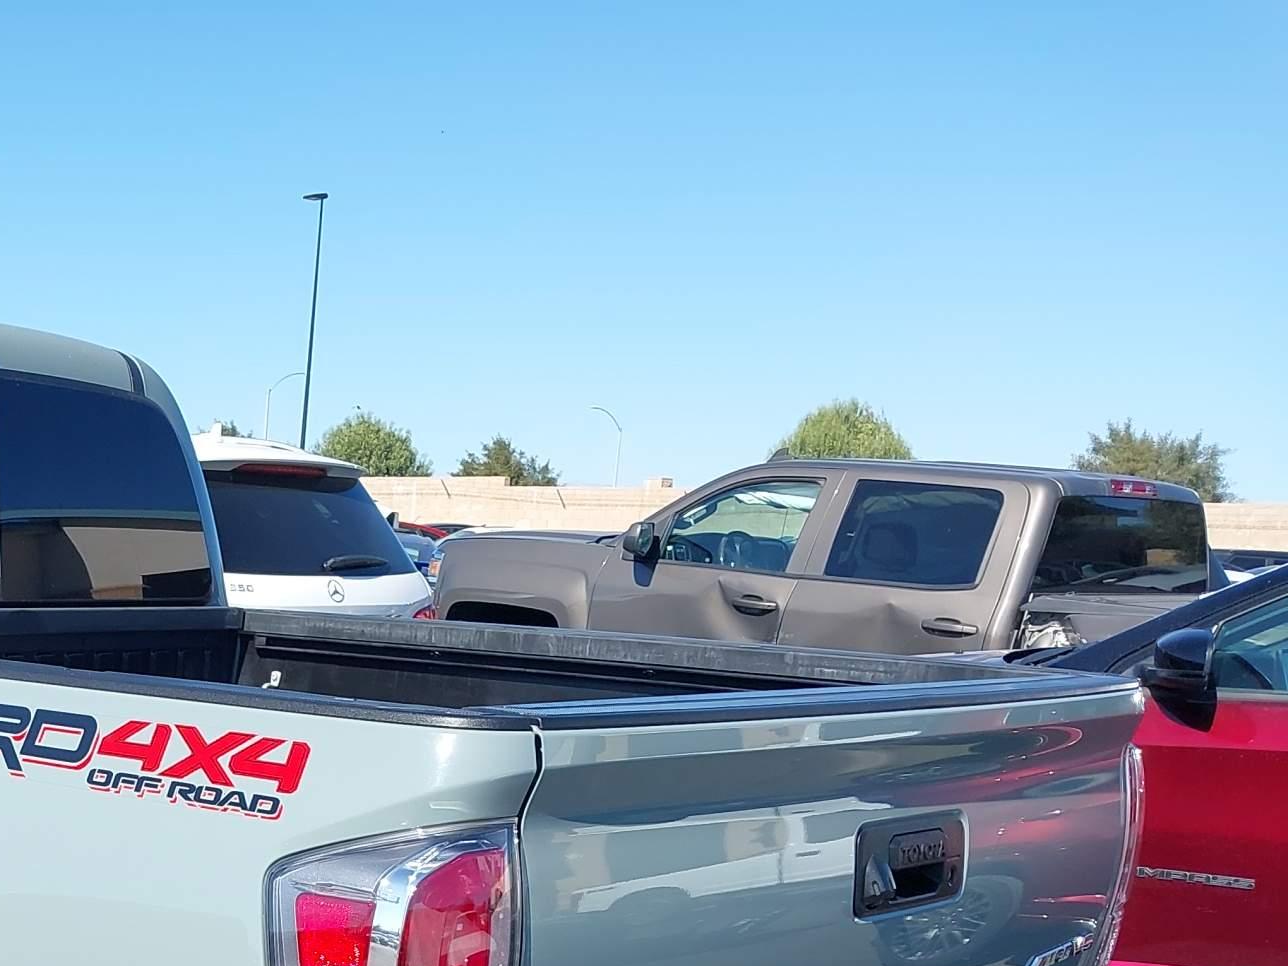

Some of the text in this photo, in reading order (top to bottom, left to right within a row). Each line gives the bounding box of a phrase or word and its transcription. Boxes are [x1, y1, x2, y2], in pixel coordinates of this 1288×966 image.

[98, 720, 311, 794] 4X4
[86, 768, 284, 820] OFF ROAD
